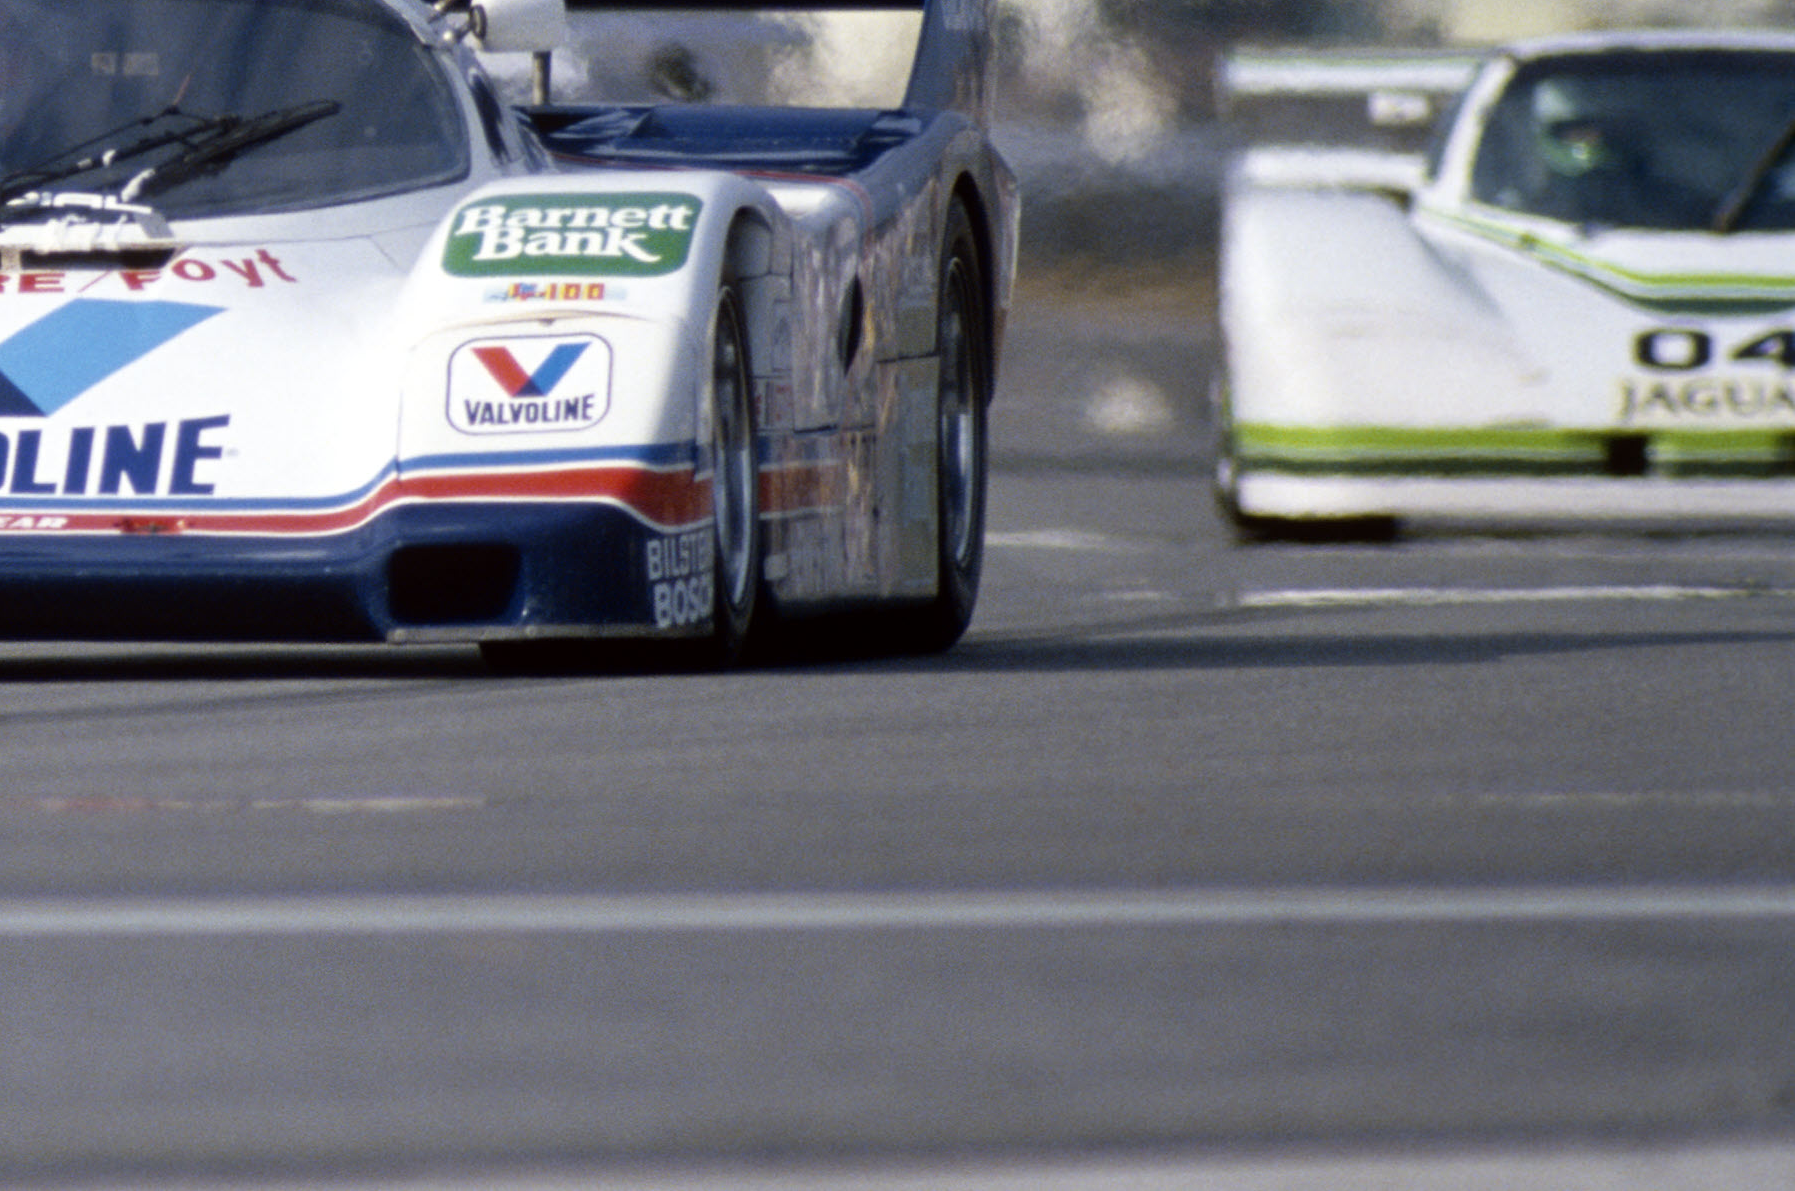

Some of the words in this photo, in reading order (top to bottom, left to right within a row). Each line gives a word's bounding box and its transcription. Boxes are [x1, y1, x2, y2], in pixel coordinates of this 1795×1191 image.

[453, 204, 693, 235] Barnett
[471, 225, 663, 263] Bank
[1633, 329, 1795, 369] 04
[464, 394, 595, 426] VALVOLINE
